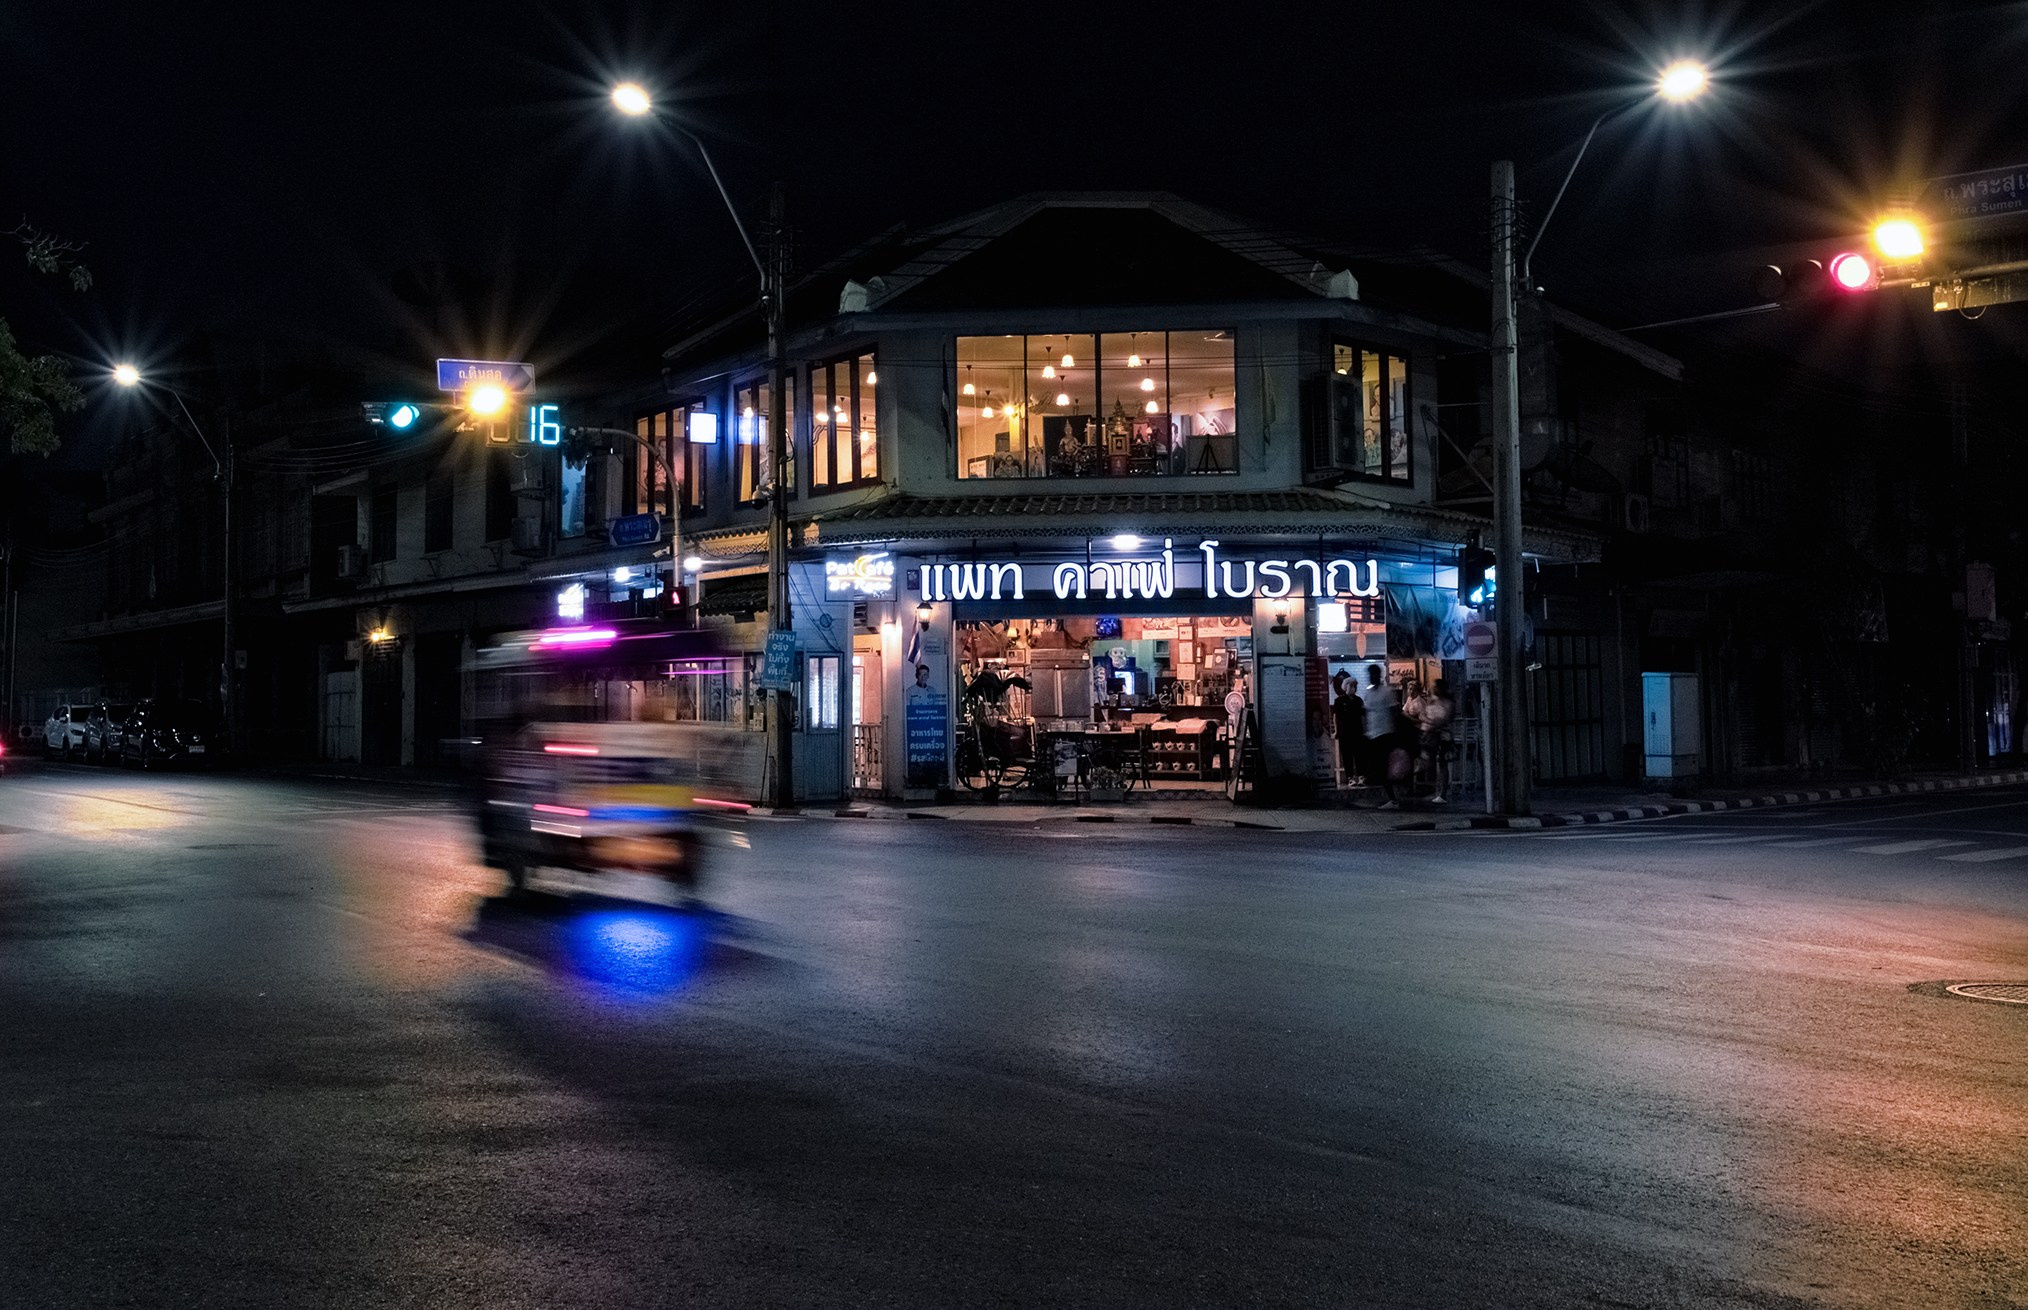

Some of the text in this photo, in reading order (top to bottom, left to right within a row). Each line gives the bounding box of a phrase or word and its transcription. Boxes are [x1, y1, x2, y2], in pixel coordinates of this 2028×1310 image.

[1944, 173, 2028, 200] ถ.พระสุเ
[1951, 199, 2022, 216] Phra Sumen
[458, 366, 502, 380] ถ.ดินสอ
[531, 405, 560, 445] 16
[920, 538, 1379, 600] แพท คาเฟ่ โบราณ
[768, 630, 795, 642] ทำงาน
[910, 727, 944, 737] อาหารไทย
